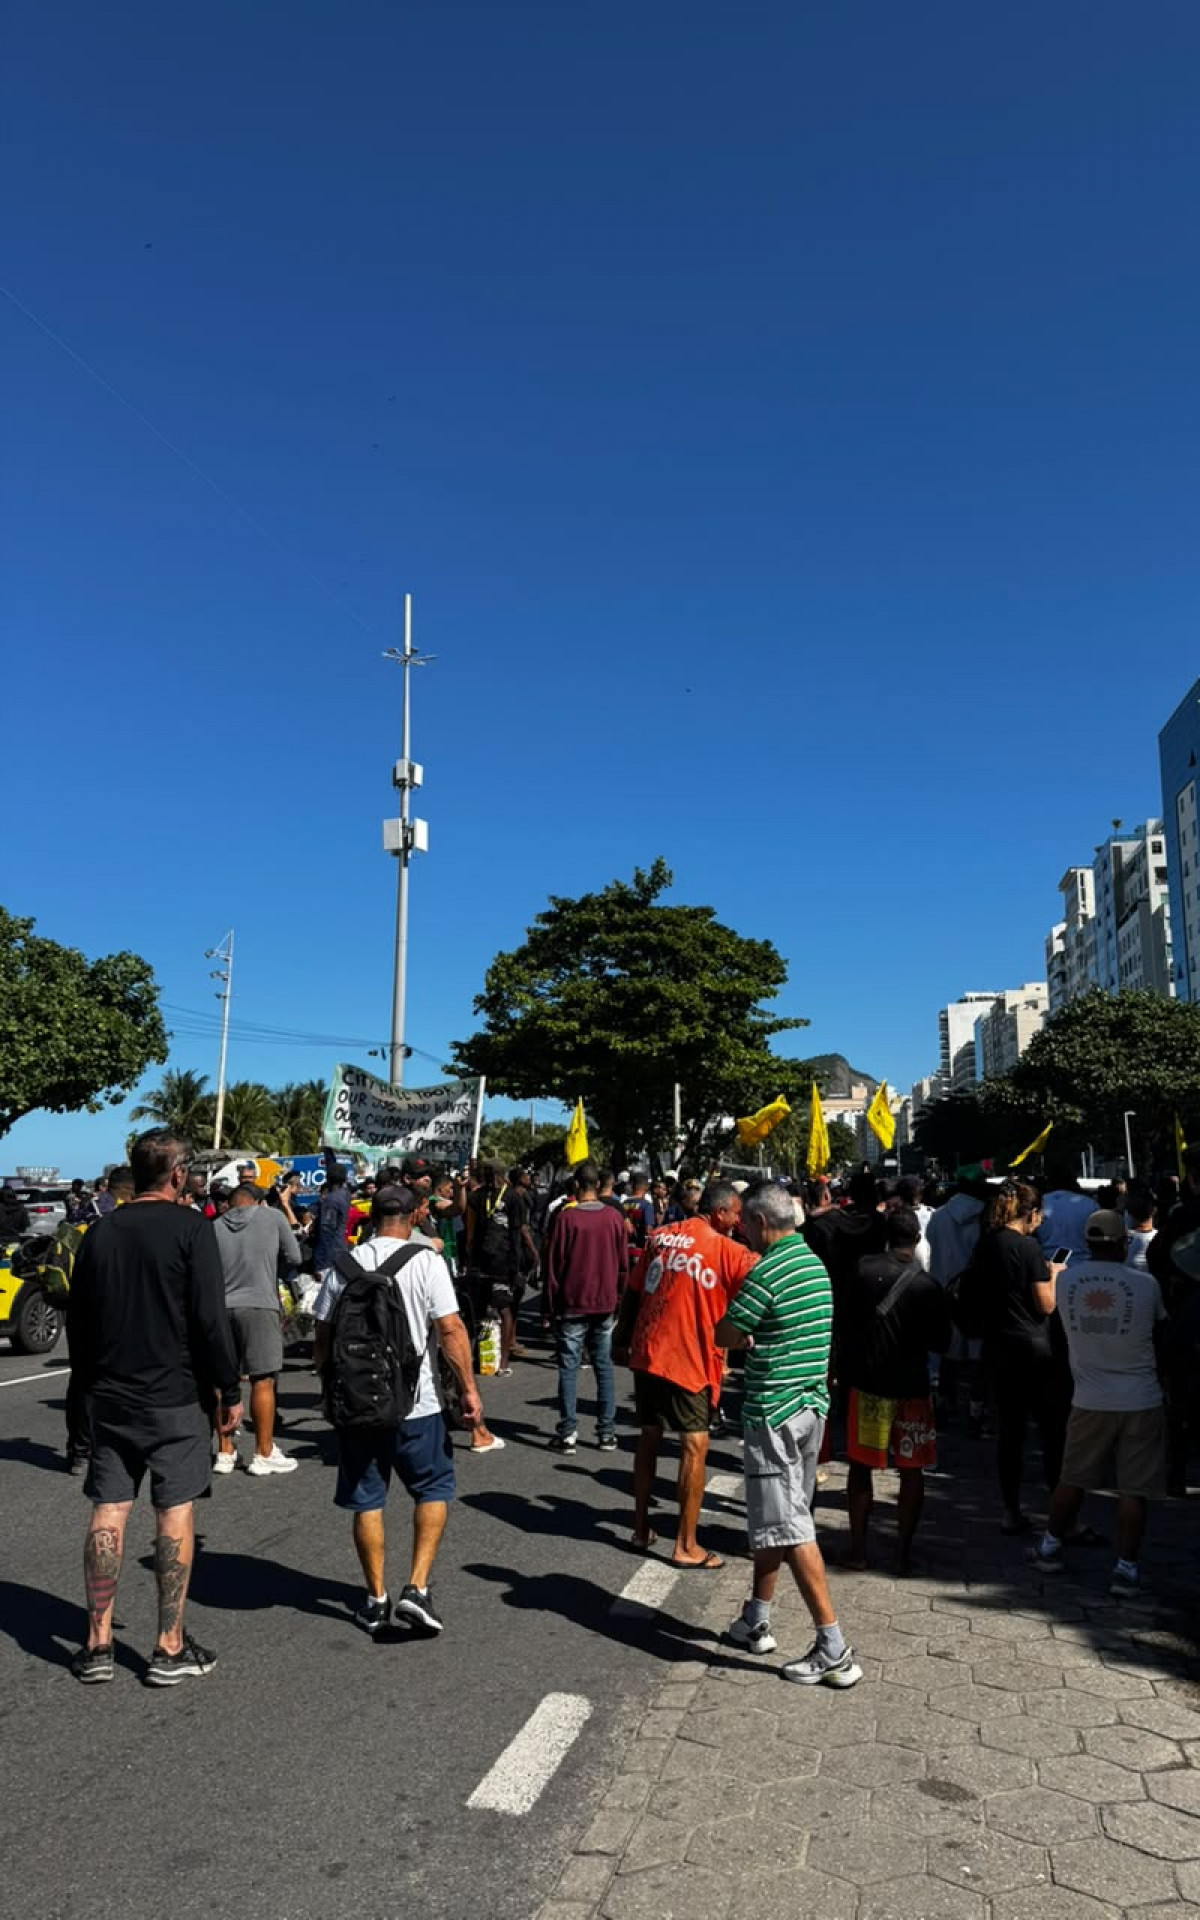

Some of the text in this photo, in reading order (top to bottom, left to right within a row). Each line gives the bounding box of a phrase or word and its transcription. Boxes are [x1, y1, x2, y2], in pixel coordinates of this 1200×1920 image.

[338, 1089, 367, 1107] OUR
[334, 1107, 360, 1125] OUR
[665, 1249, 718, 1290] leão
